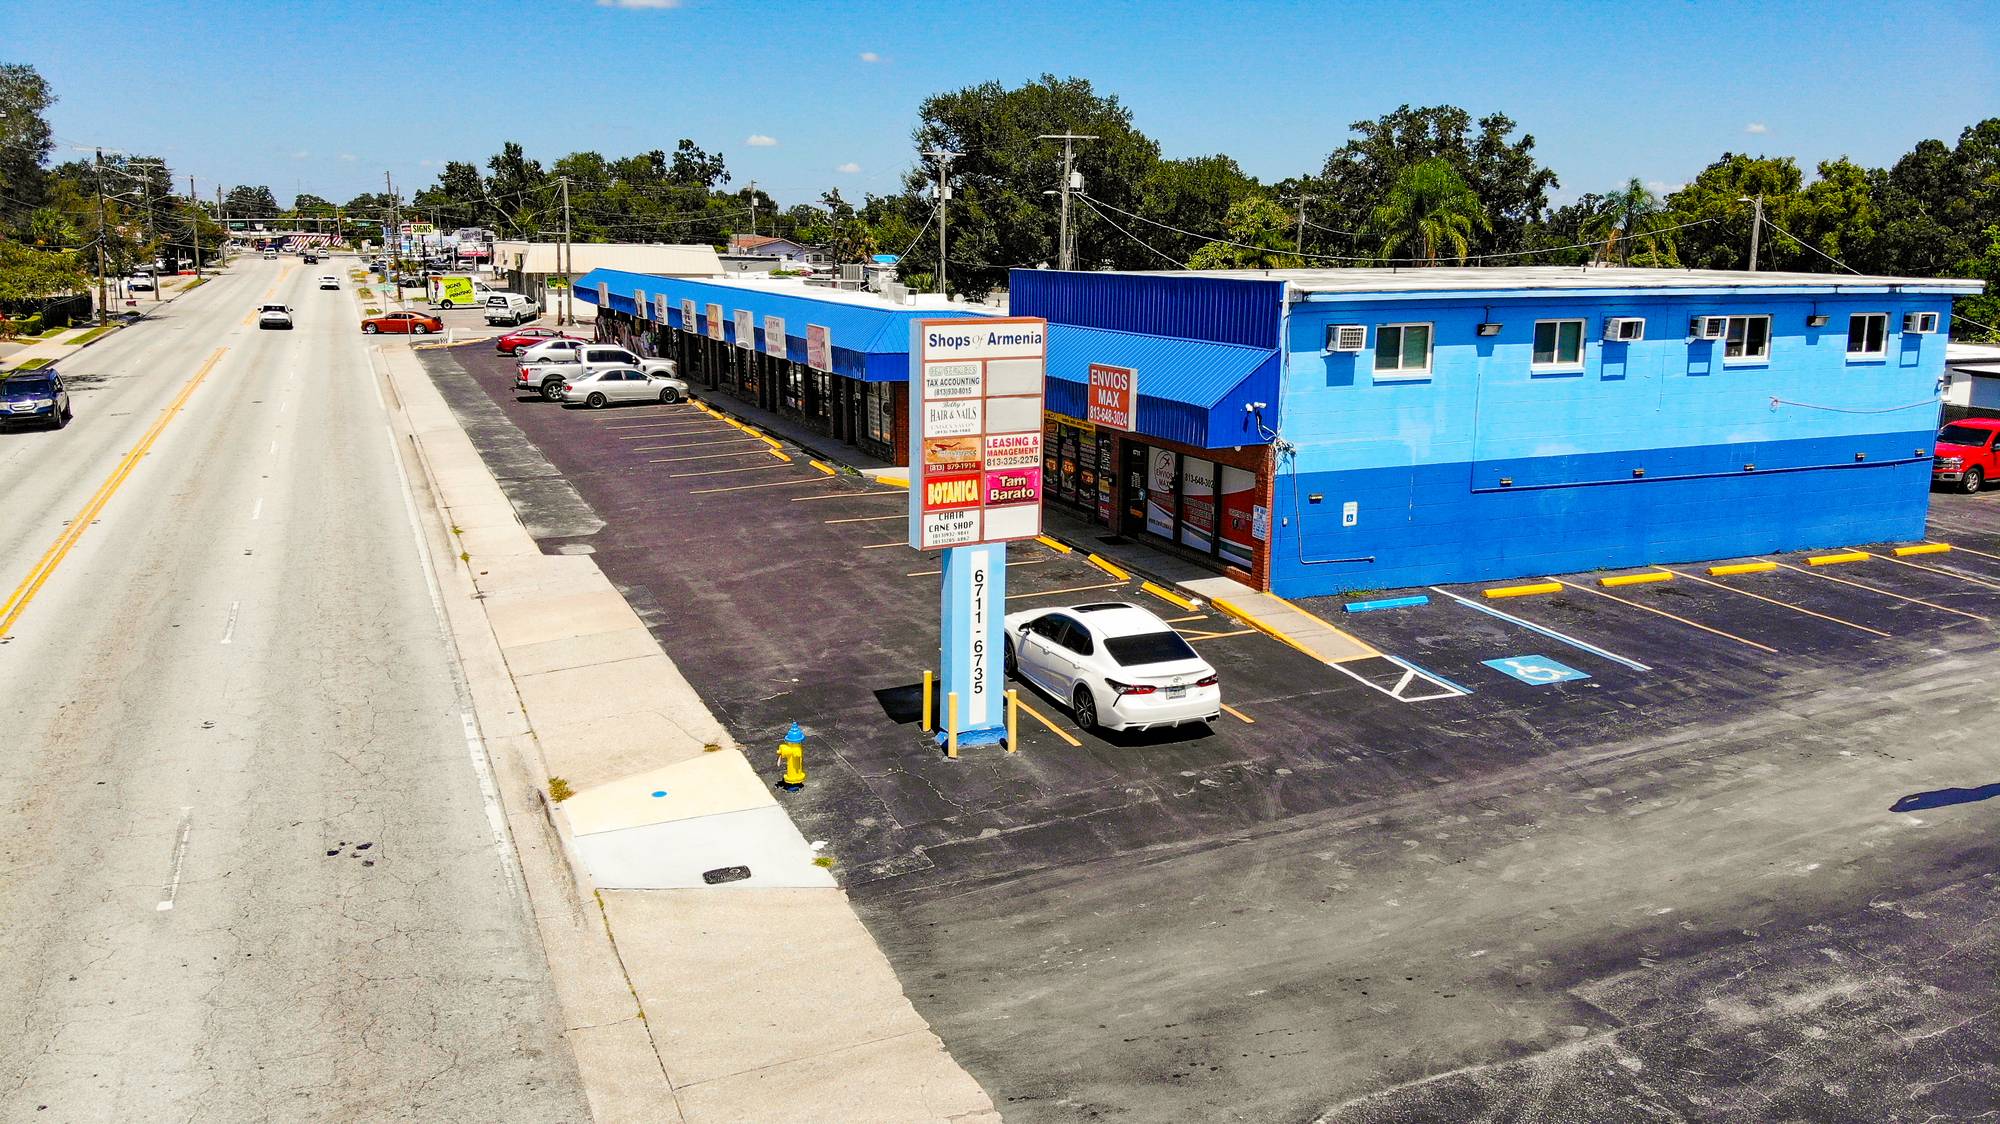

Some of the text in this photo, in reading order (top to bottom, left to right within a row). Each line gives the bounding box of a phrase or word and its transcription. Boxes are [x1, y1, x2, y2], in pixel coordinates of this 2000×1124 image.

[413, 224, 431, 233] SIGNS
[929, 333, 970, 350] Shops
[987, 331, 1042, 346] Armenia
[927, 377, 980, 388] TAX ACCOUNTING
[1091, 369, 1127, 390] ENVIOS
[1098, 388, 1120, 408] MAX
[930, 407, 977, 423] HAIR & NAILS
[1090, 405, 1127, 427] 813-648-3024
[987, 437, 1029, 448] LEASING
[1032, 436, 1039, 446] &
[987, 447, 1039, 457] MANAGEMENT
[987, 455, 1039, 466] 813-325-2276
[929, 464, 945, 472] (813)
[1156, 468, 1174, 480] ENVIOS
[999, 475, 1027, 487] Tam
[927, 480, 979, 505] BOTANICA
[990, 487, 1035, 501] Barato
[938, 511, 964, 521] CHAIR
[928, 521, 974, 533] CANE SHOP
